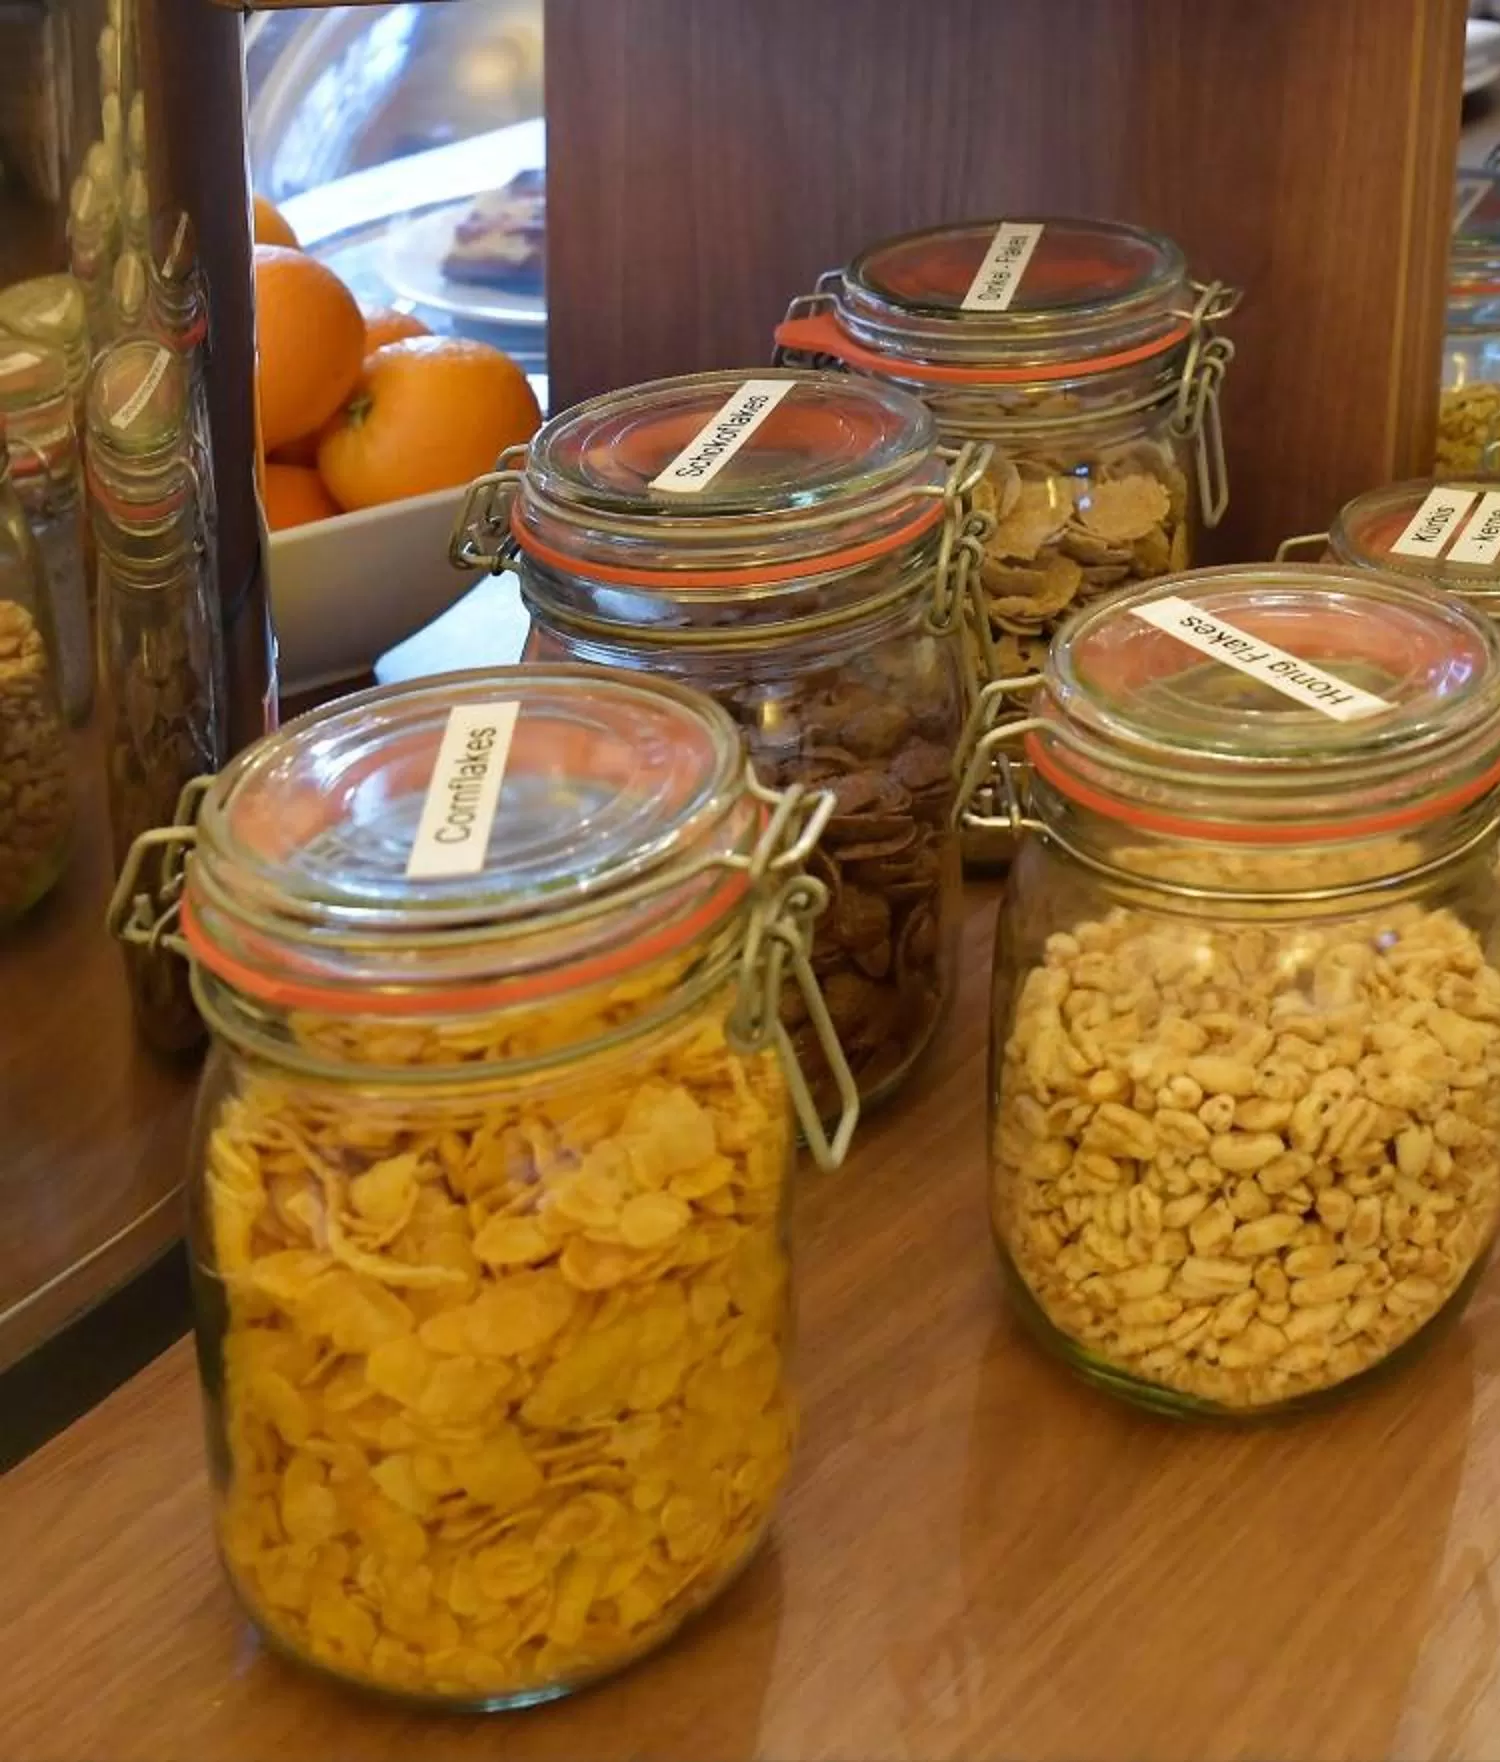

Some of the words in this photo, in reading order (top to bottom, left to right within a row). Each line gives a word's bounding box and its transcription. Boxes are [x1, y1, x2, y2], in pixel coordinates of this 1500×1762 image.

[675, 395, 769, 477] Schokoflakes
[1411, 504, 1456, 543] Kürbis
[1178, 614, 1269, 664] Flakes
[1265, 659, 1356, 706] Honig
[433, 726, 497, 844] Cornflakes
